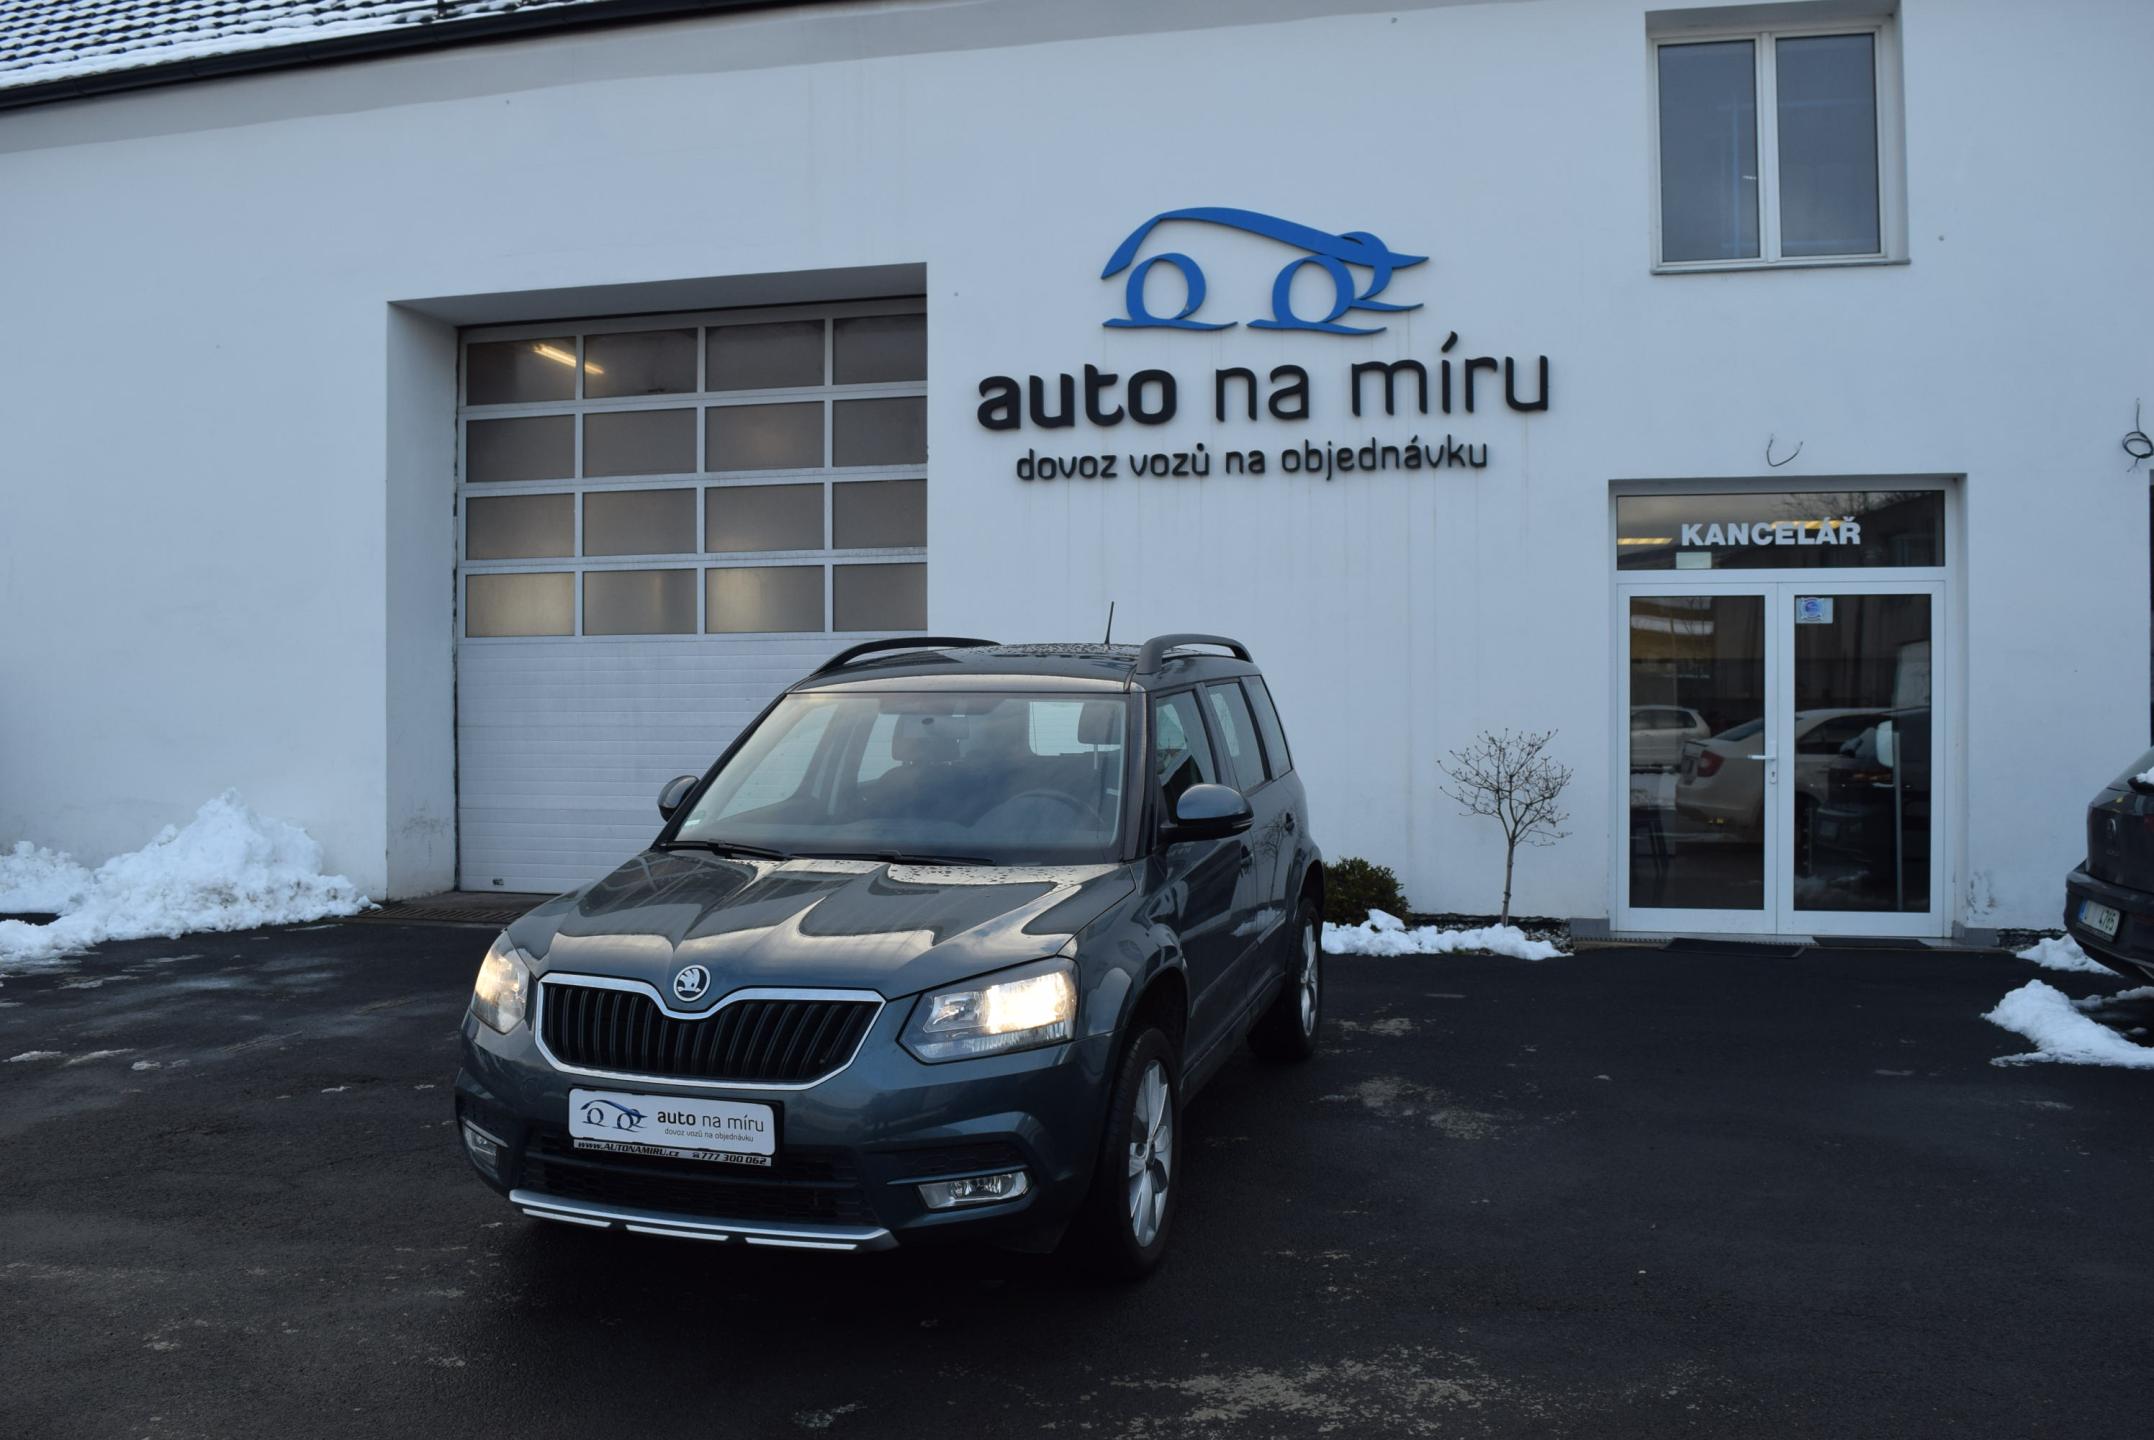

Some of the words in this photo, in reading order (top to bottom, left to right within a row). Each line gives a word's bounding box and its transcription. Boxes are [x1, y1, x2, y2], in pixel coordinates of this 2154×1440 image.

[977, 363, 1178, 433] auto
[1215, 364, 1310, 423] na
[1351, 331, 1550, 418] míru
[1016, 449, 1118, 482] dovoz
[1129, 442, 1210, 479] vozů
[1225, 450, 1266, 475] na
[1281, 434, 1488, 482] objednávku
[1681, 515, 1861, 546] KANCELÁŘ
[657, 1110, 697, 1127] auto
[702, 1115, 721, 1129] na
[727, 1114, 764, 1133] míru
[664, 1127, 685, 1136] dovoz
[704, 1131, 714, 1139] na
[714, 1132, 754, 1143] objednávku
